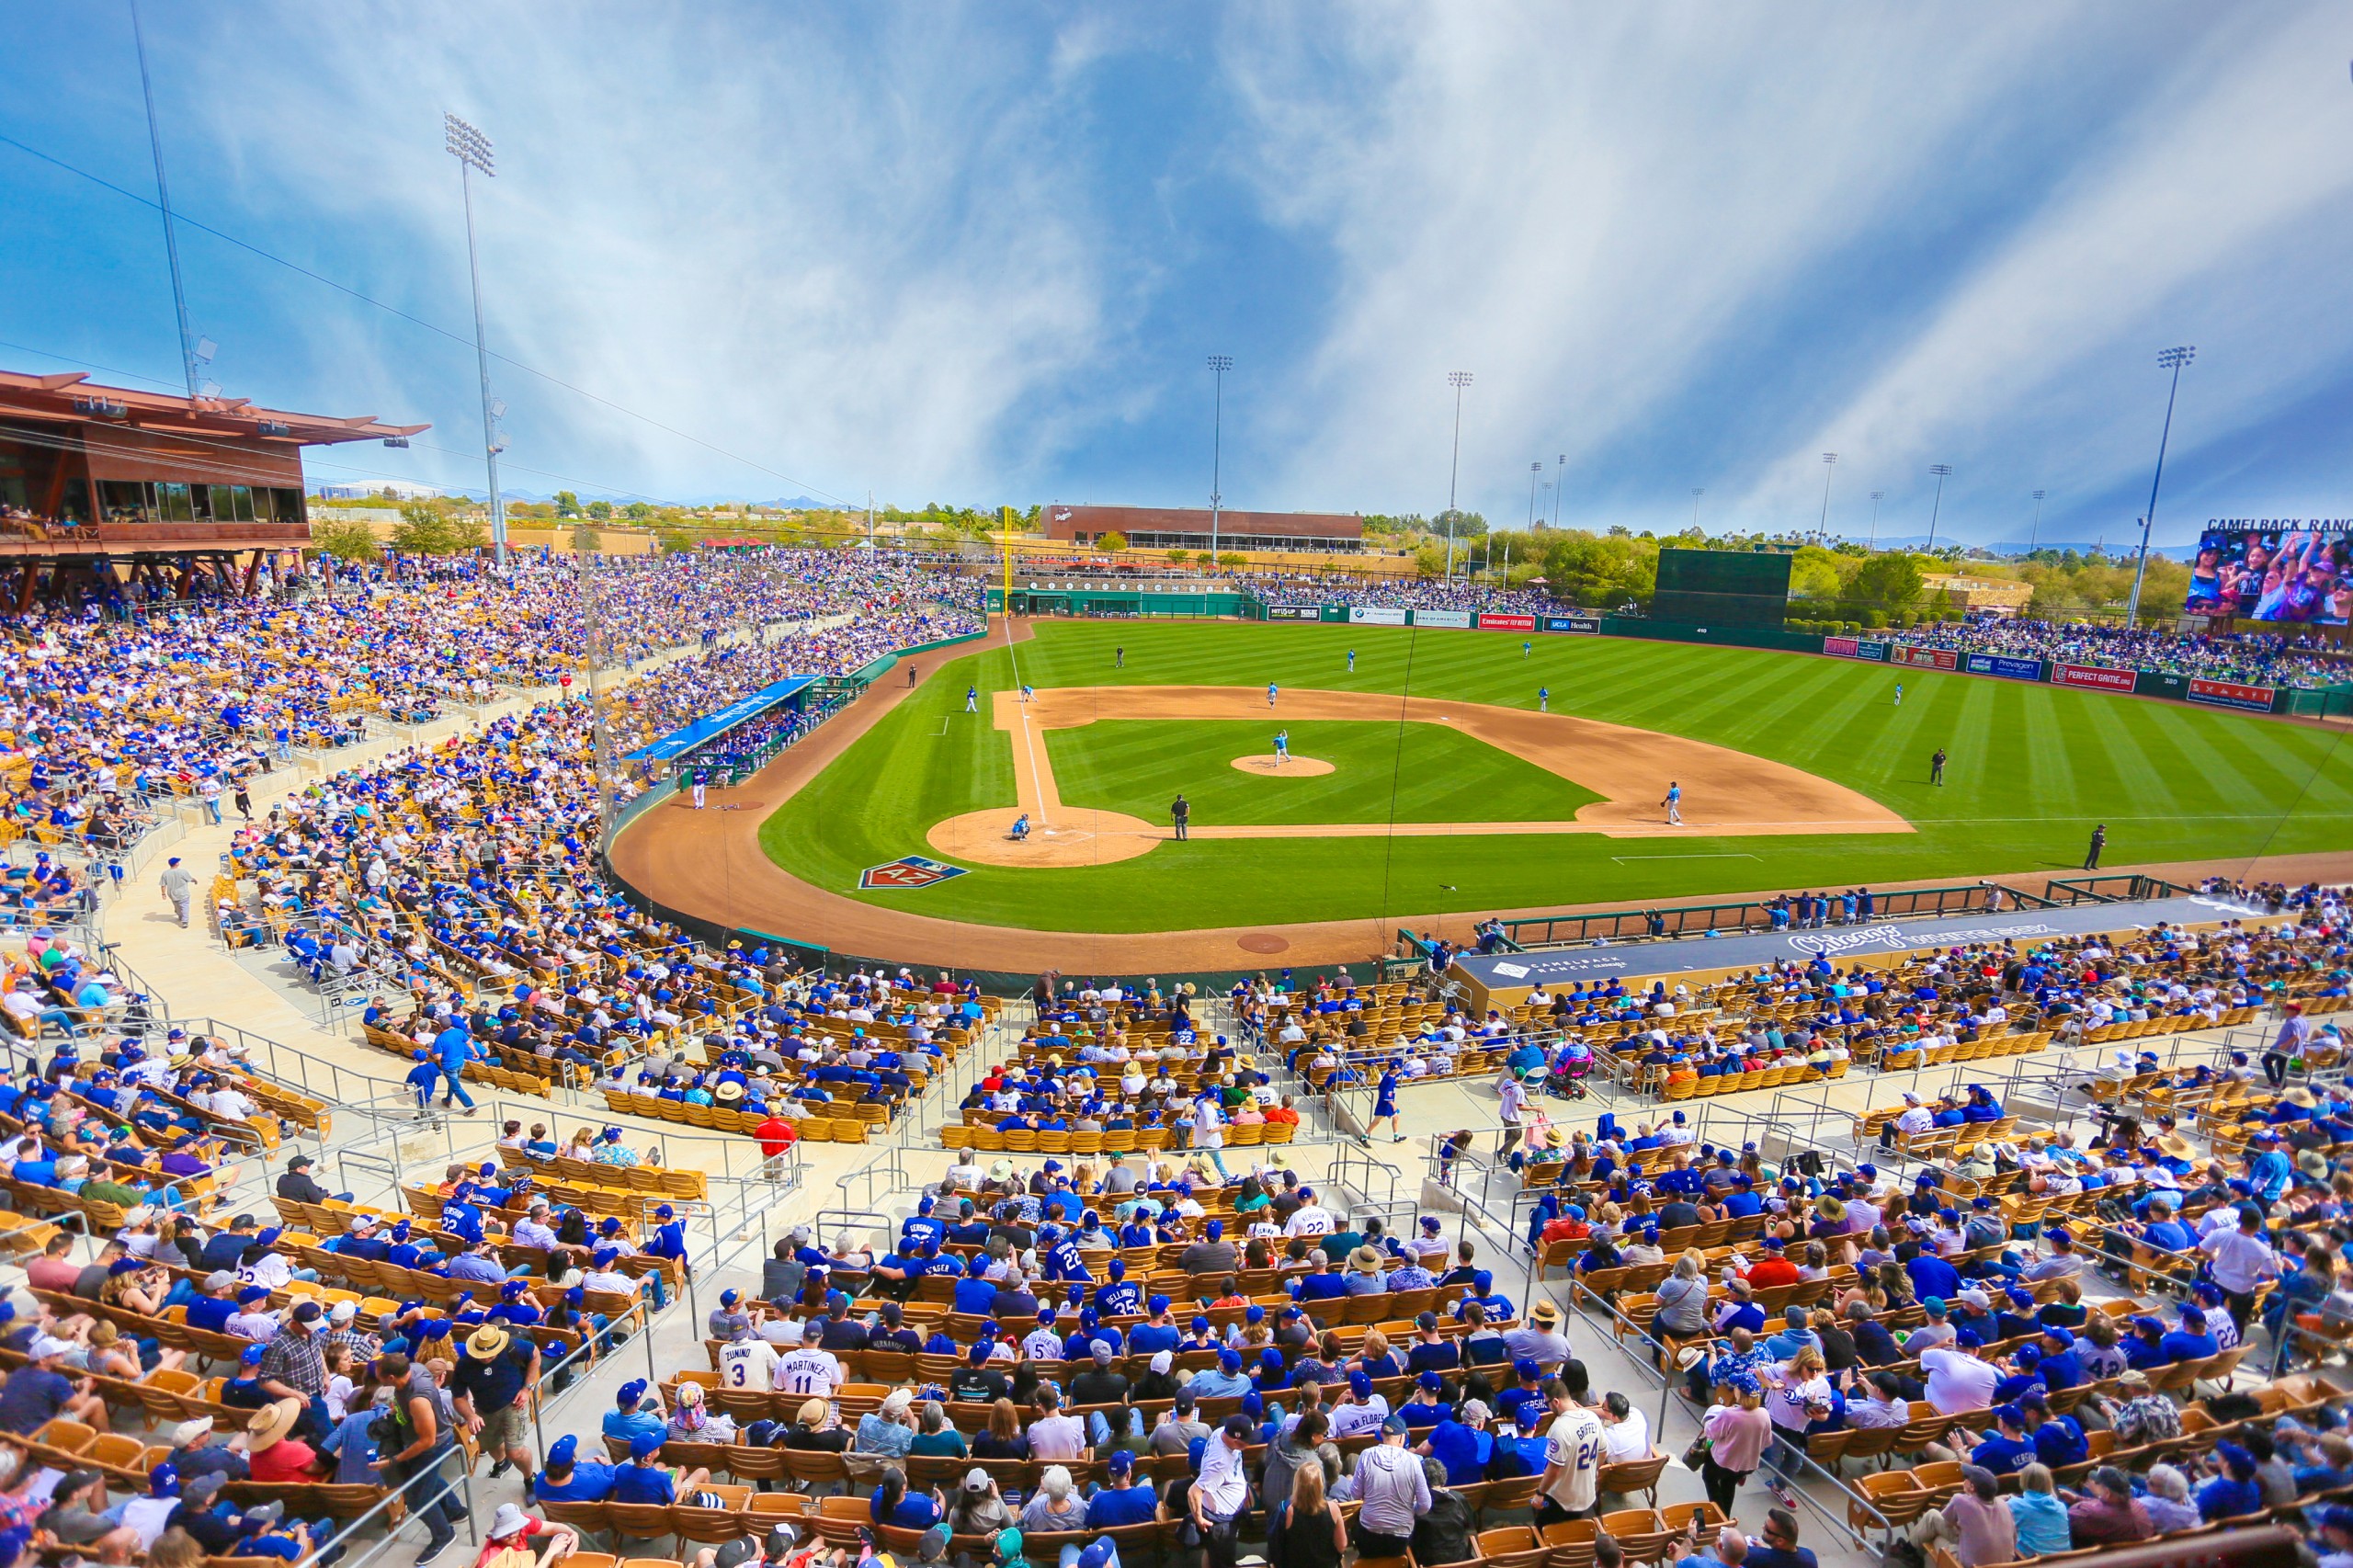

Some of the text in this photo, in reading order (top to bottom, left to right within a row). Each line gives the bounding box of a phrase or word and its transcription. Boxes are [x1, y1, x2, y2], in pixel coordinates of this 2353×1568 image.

[2208, 518, 2302, 531] CAMELBACK
[1570, 621, 1593, 630] Health
[1998, 659, 2033, 670] Prevagen
[2068, 671, 2097, 682] PERFECT
[877, 868, 932, 884] AZ
[1788, 923, 2062, 956] Chicago WHITE SOX
[1530, 956, 1620, 970] CAMELBACK
[1537, 963, 1589, 974] RANCH
[331, 998, 339, 1006] 14
[1179, 1035, 1192, 1045] 22
[441, 1219, 458, 1233] 22
[1306, 1221, 1324, 1234] 22
[1063, 1248, 1082, 1272] 22
[1114, 1301, 1137, 1314] 35
[1030, 1335, 1051, 1346] SEAGER
[2216, 1325, 2239, 1350] 22
[873, 1340, 906, 1350] HERNANDEZ
[1034, 1344, 1044, 1359] 5
[725, 1347, 751, 1361] ZUNINO
[732, 1363, 746, 1387] 3
[786, 1360, 827, 1376] MARTINEZ
[795, 1375, 813, 1394] 11
[1576, 1437, 1598, 1471] 24
